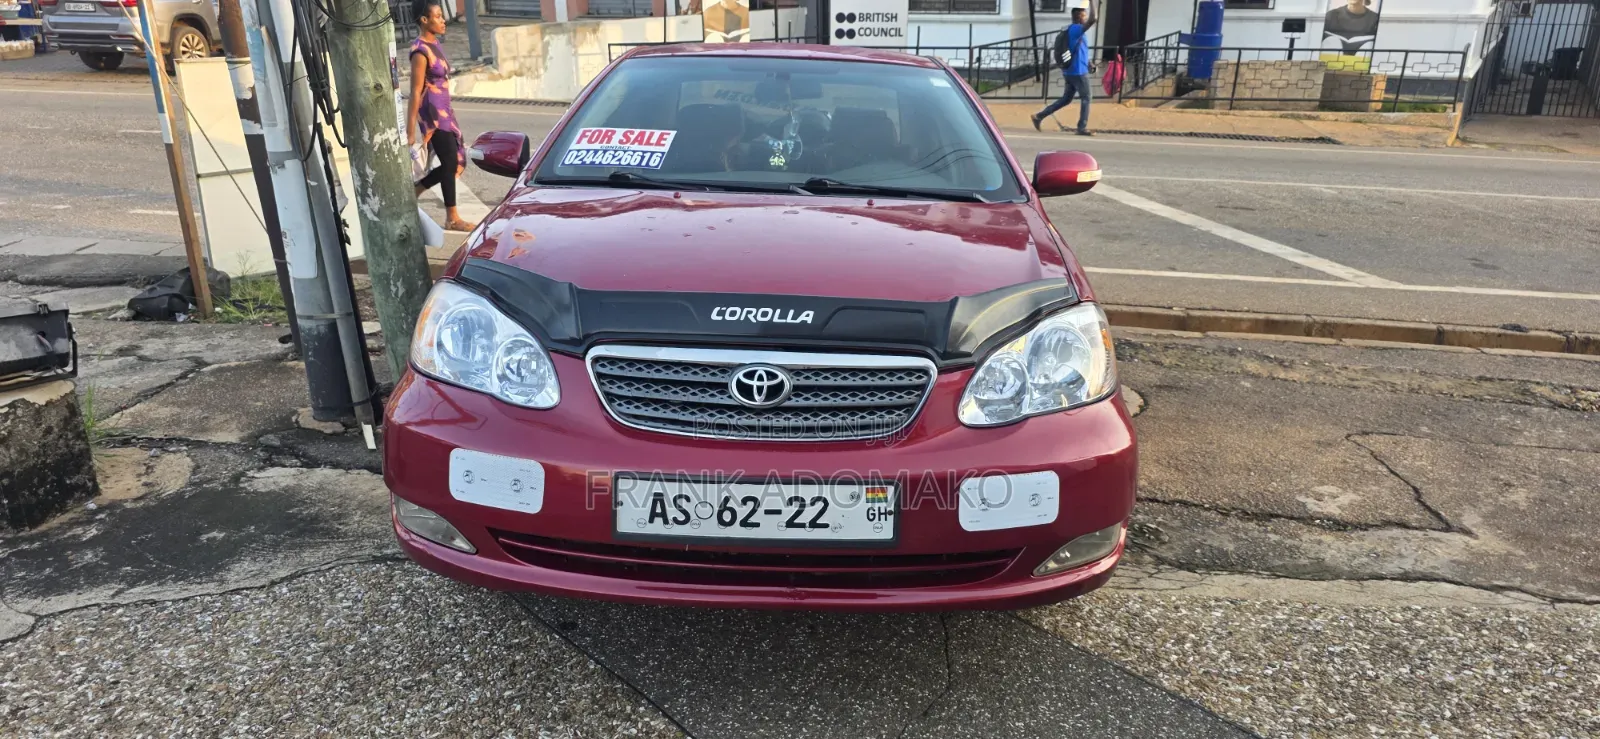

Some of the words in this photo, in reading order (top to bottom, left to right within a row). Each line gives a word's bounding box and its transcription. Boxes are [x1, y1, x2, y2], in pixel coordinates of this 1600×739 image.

[858, 12, 898, 23] BRITISH
[857, 27, 903, 37] COUNCIL
[576, 129, 617, 145] FOR
[618, 130, 671, 147] SALE
[564, 150, 662, 167] 0244626616
[710, 306, 815, 324] COROLLA
[648, 492, 692, 526] AS
[716, 495, 830, 529] 62-22
[866, 506, 888, 523] GH
